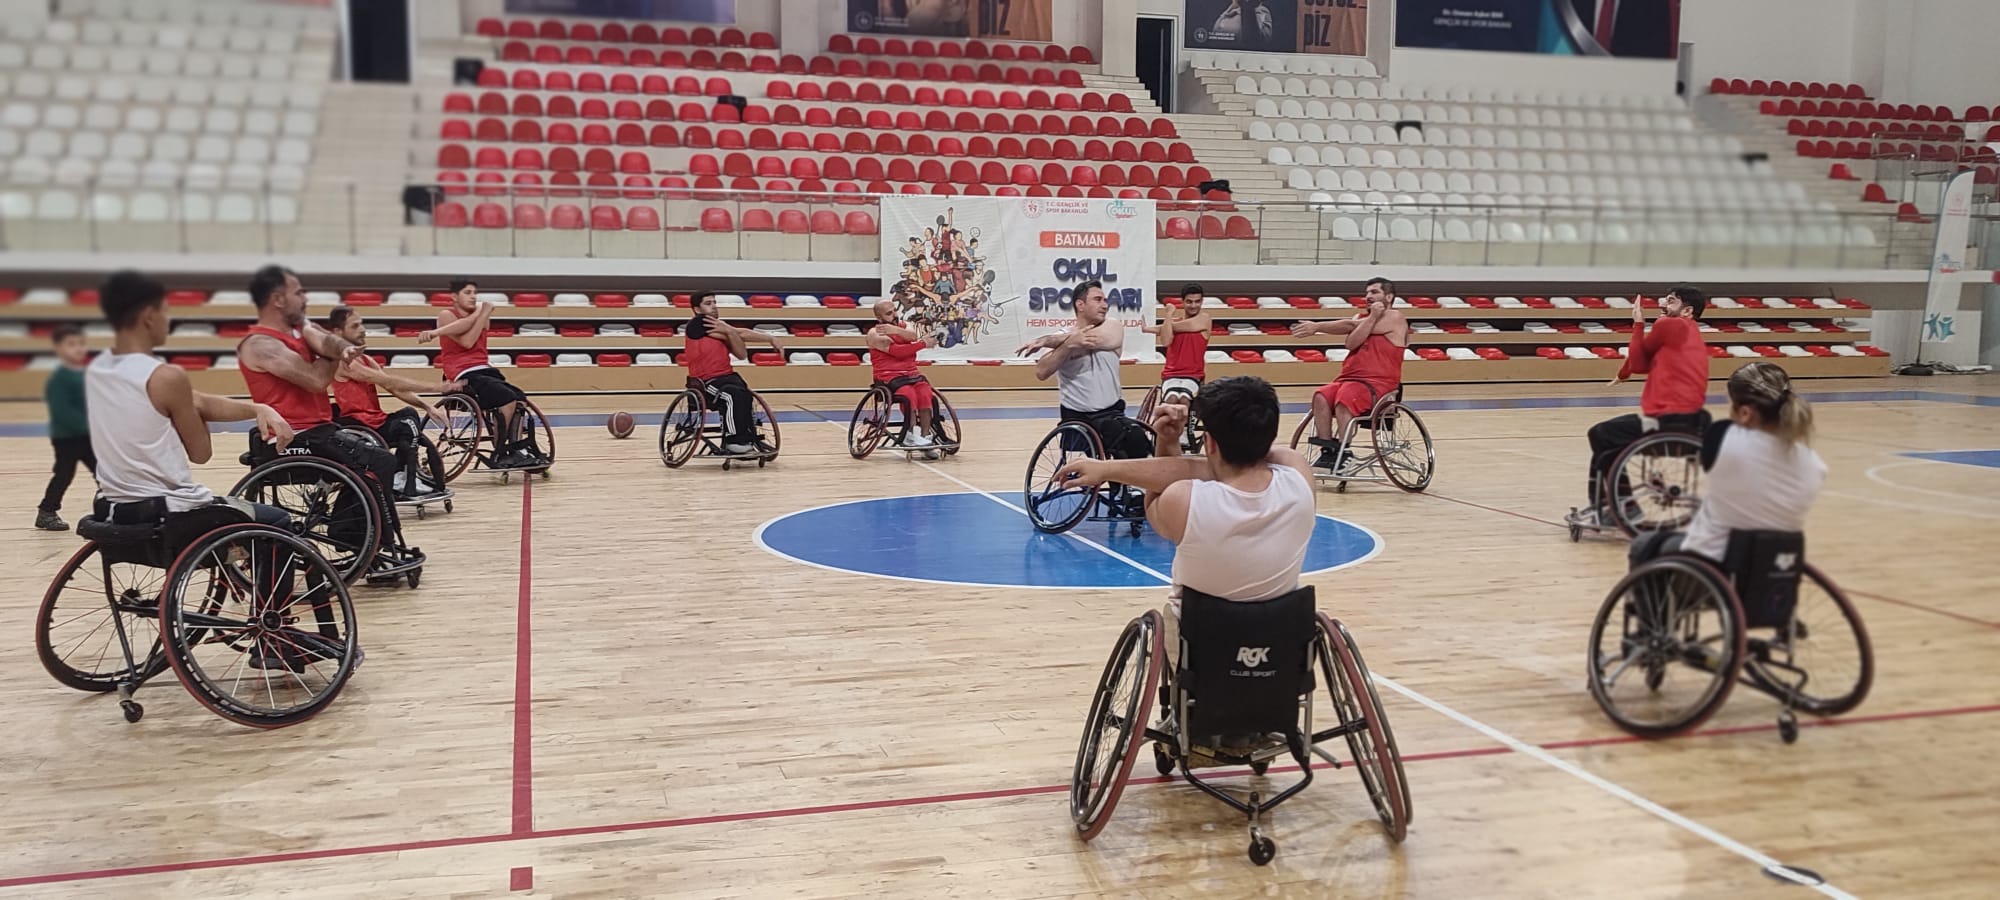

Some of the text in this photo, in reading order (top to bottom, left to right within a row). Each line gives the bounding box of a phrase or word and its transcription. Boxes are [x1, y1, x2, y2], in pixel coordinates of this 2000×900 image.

[1055, 233, 1106, 247] BATMAN
[1053, 257, 1118, 282] OKUL
[1028, 287, 1142, 312] SPOARI
[1026, 319, 1046, 327] HEM
[1236, 646, 1270, 667] RGK
